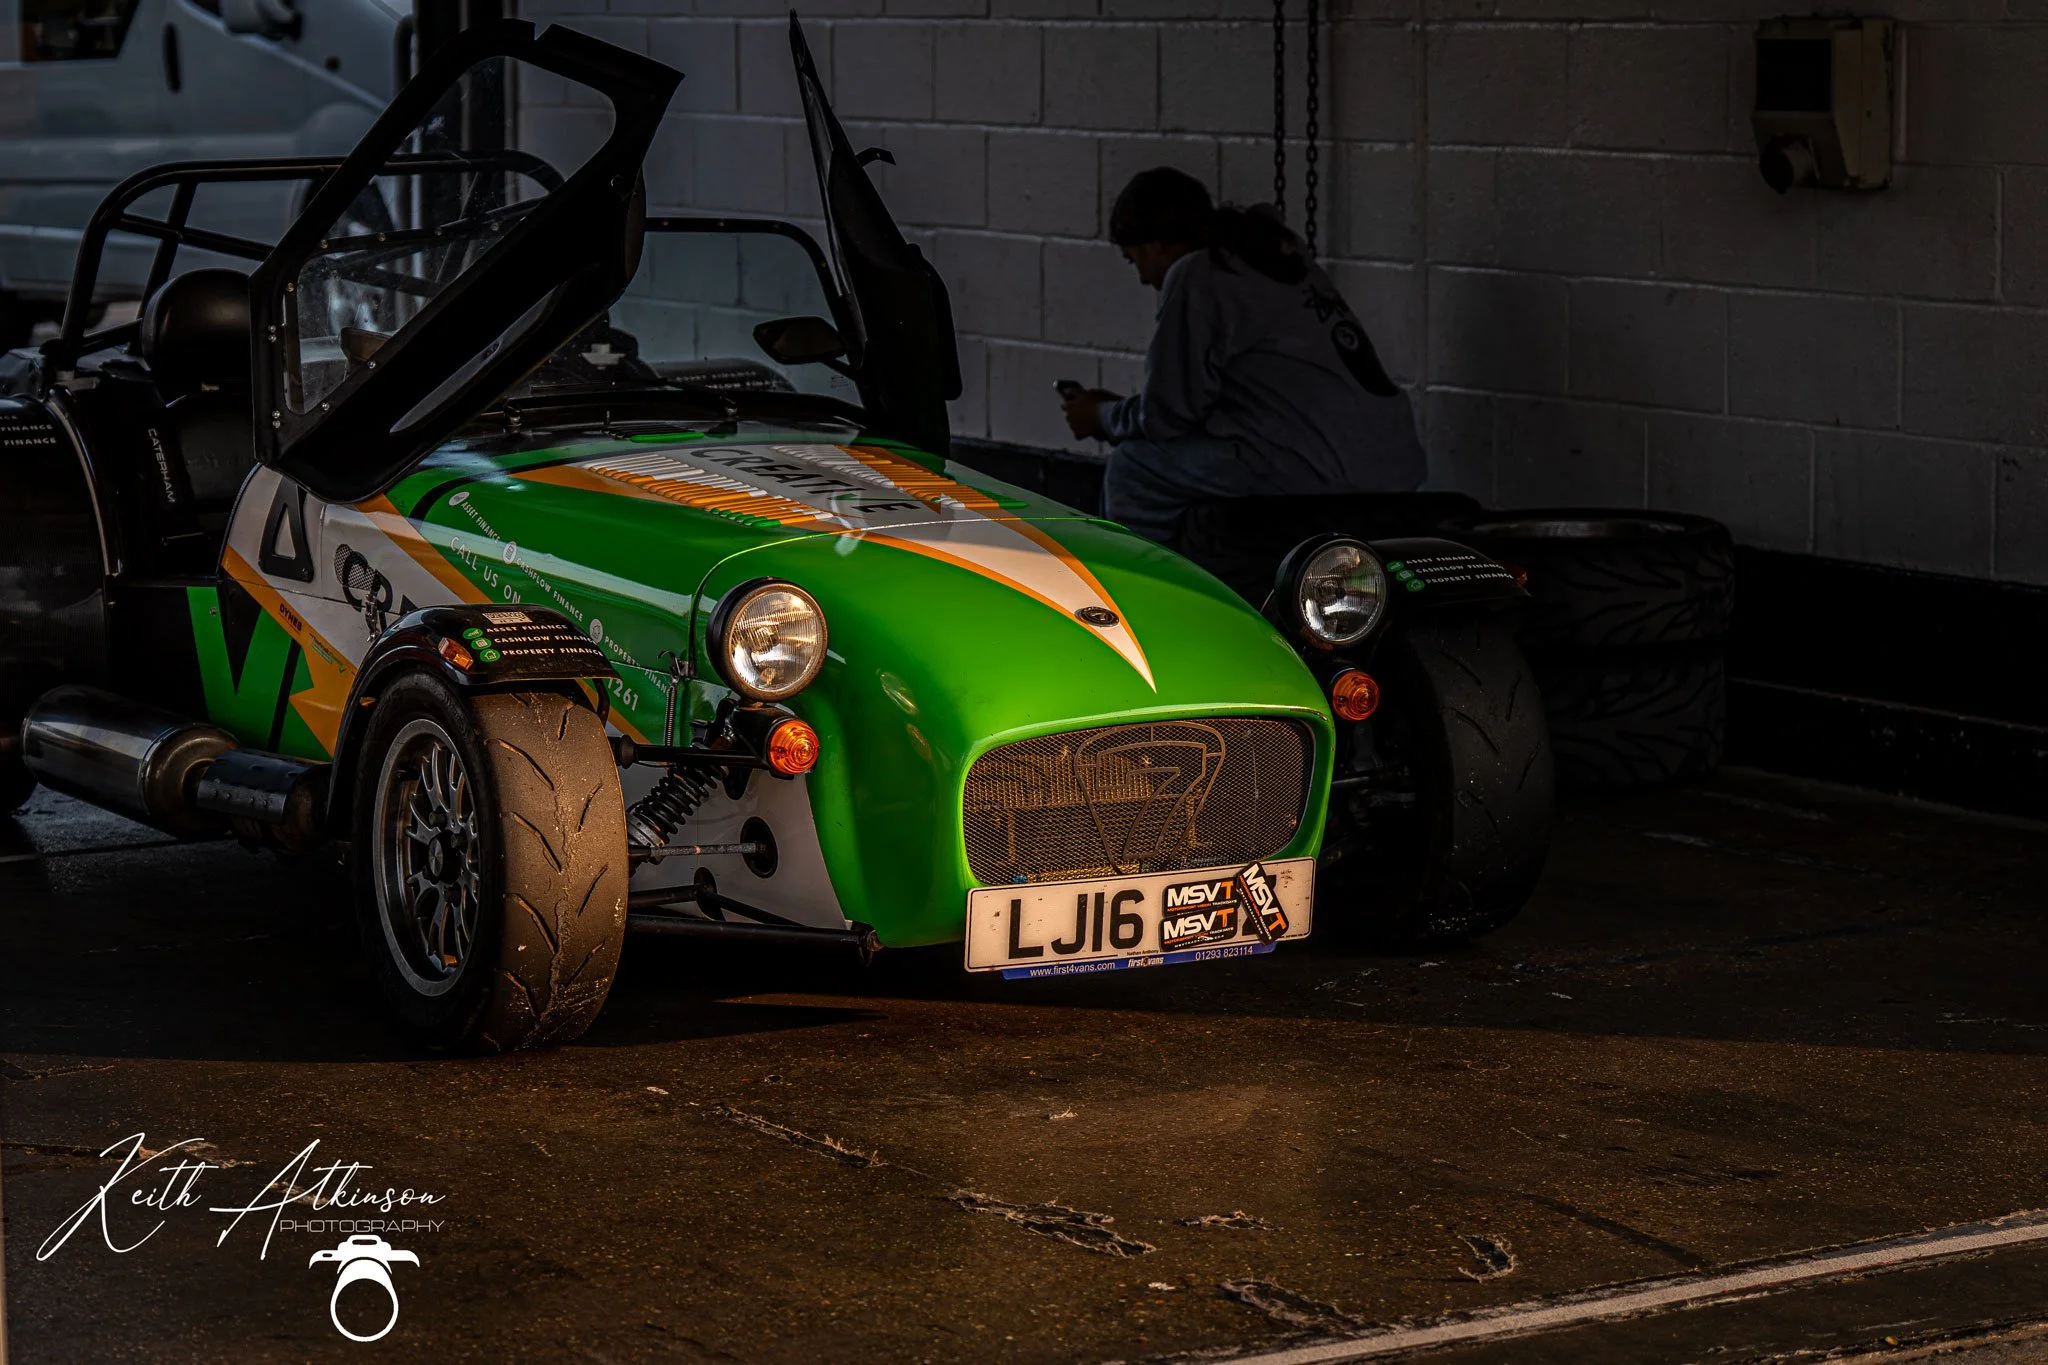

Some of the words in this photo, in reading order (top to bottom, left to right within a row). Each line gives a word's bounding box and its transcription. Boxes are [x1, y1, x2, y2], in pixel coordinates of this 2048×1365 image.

[148, 428, 176, 503] CATERHAM
[461, 502, 478, 519] ASSET
[476, 517, 500, 543] FINANCE
[450, 537, 477, 570] CALL
[484, 566, 498, 587] US
[504, 585, 521, 604] ON
[1426, 574, 1472, 584] PROPERTY
[516, 558, 551, 592] CASHFLOW
[553, 591, 583, 621] FINANCE
[494, 635, 550, 643] CASHFLOW
[502, 648, 554, 656] PROPERTY
[1167, 880, 1234, 907] MSVT
[1242, 863, 1287, 931] MSVT
[1163, 907, 1234, 940] MSVT
[1195, 950, 1220, 960] 01293
[1223, 946, 1253, 957] 823114
[1030, 961, 1116, 977] www.first4vans.com
